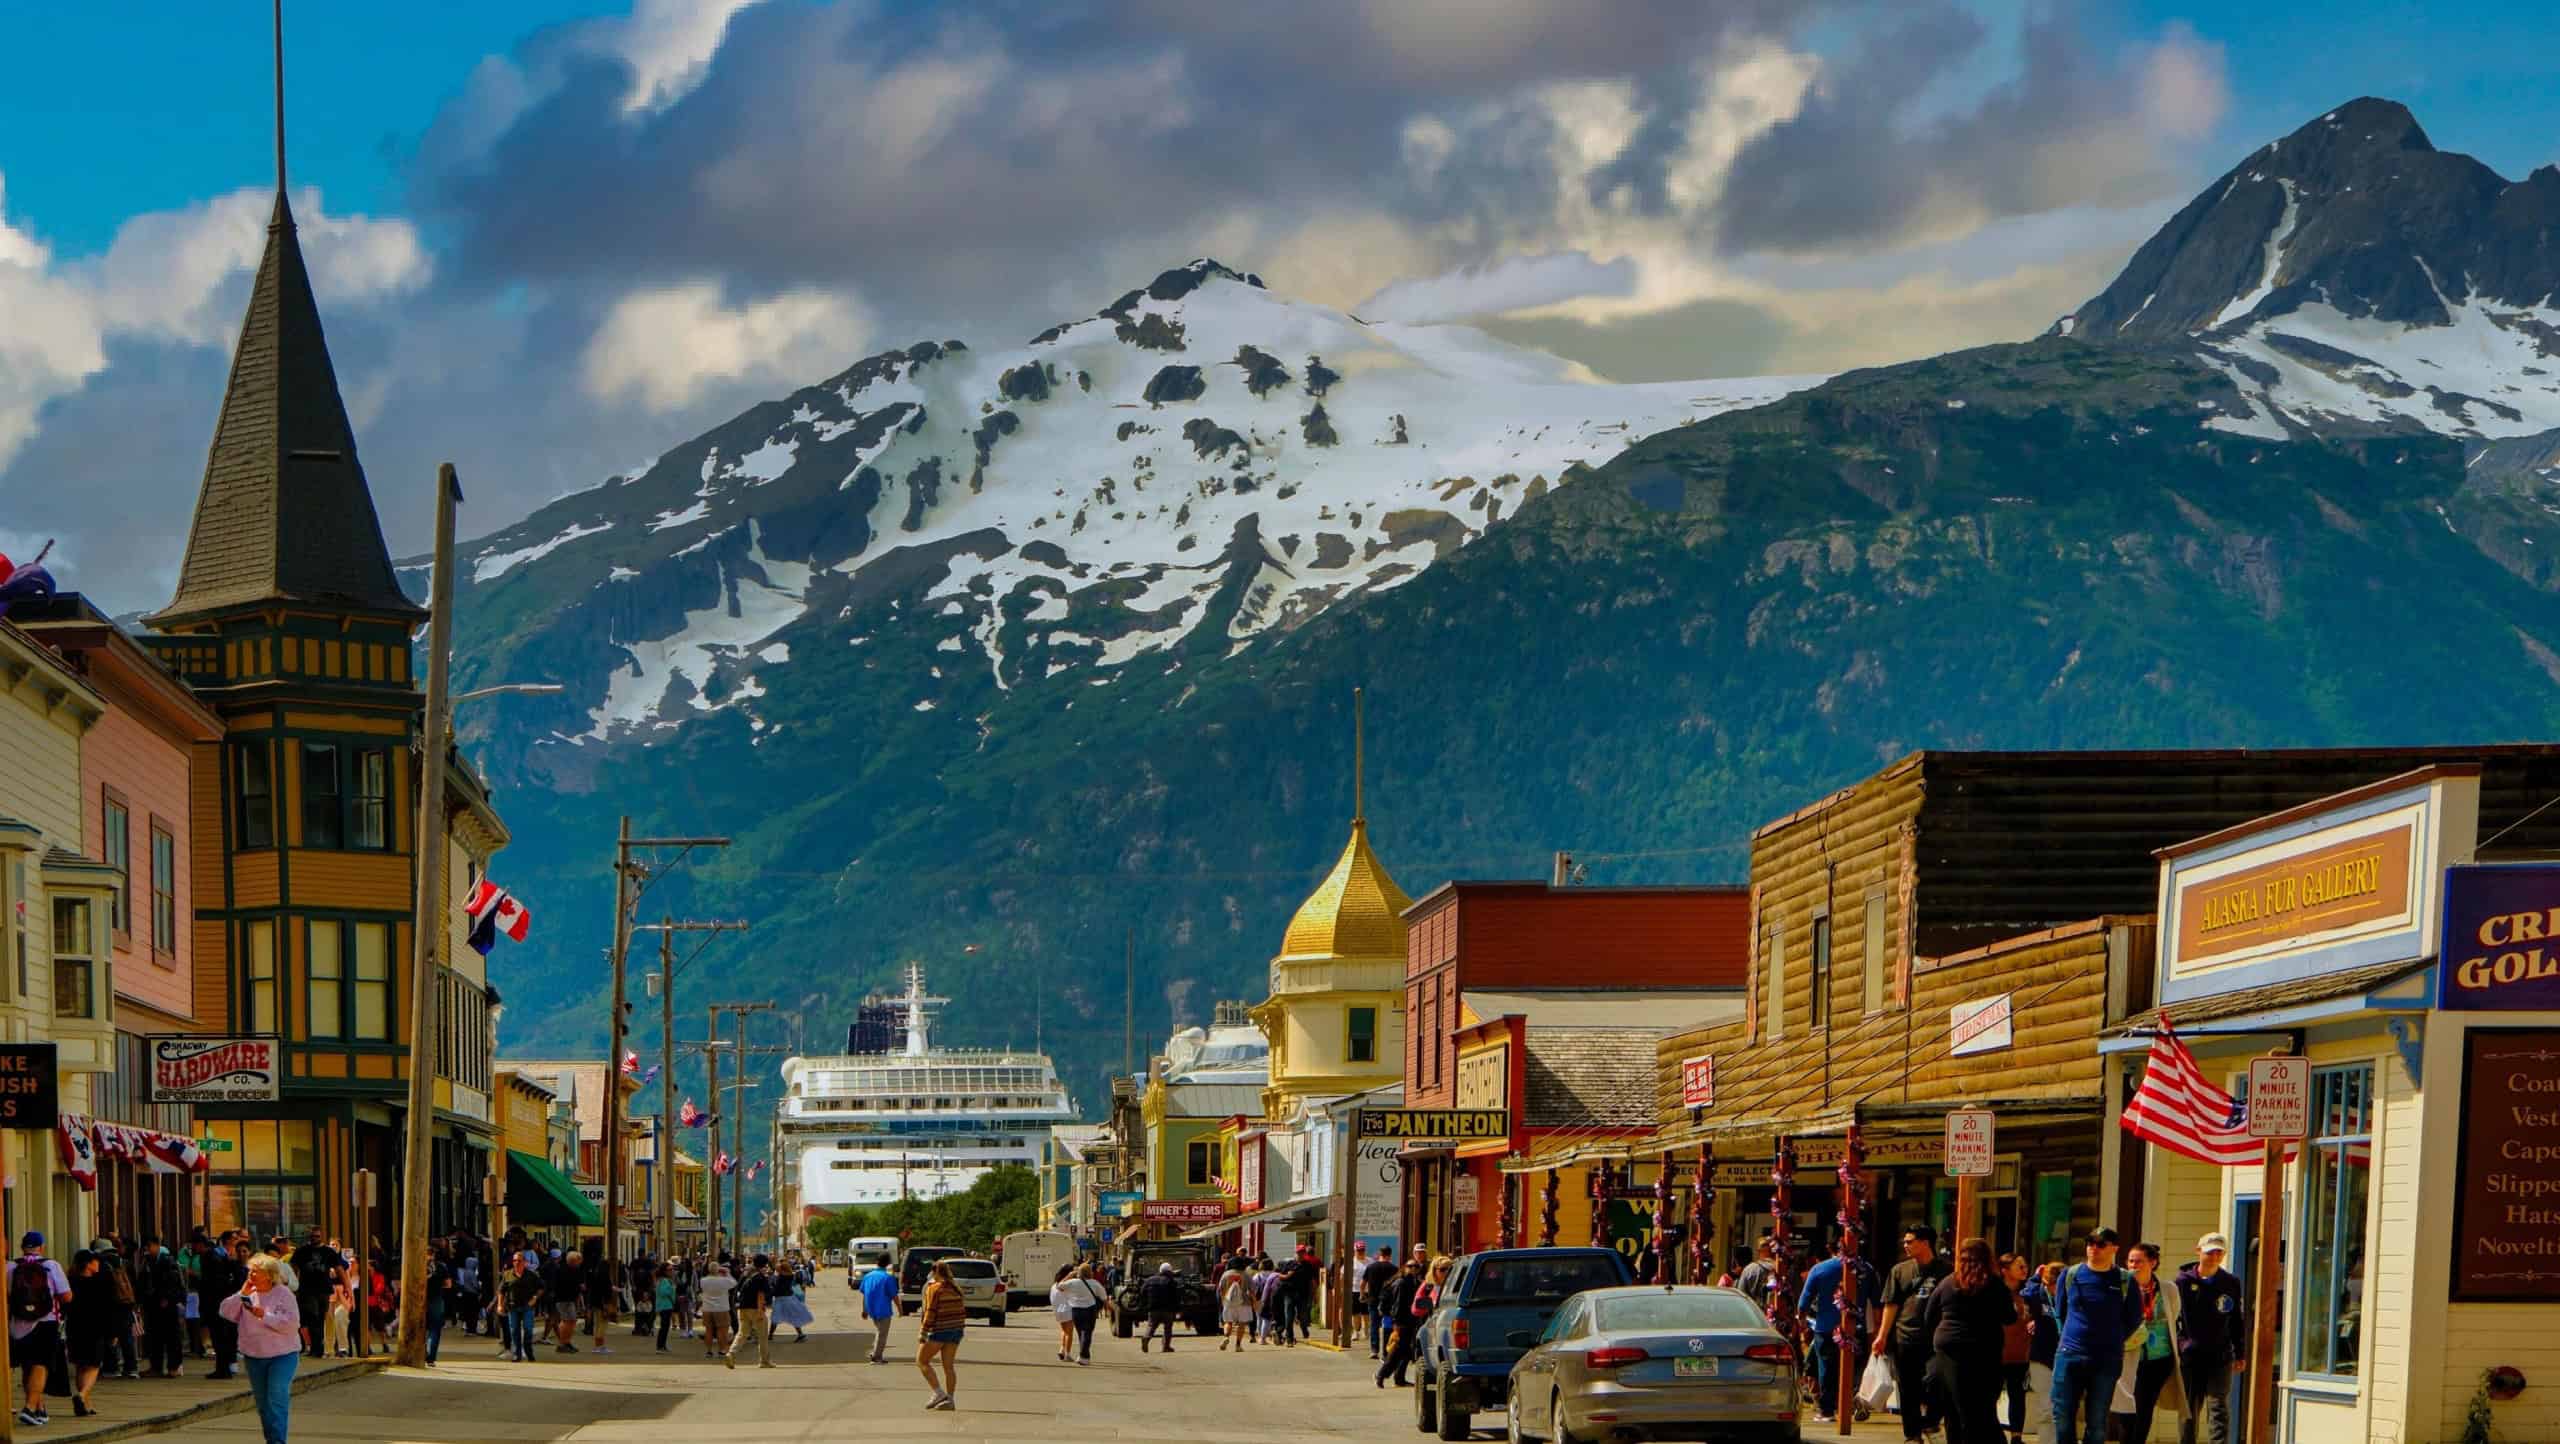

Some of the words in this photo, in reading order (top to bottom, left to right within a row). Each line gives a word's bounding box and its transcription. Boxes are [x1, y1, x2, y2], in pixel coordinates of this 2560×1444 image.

[2200, 887, 2259, 933] ALASKA
[2264, 877, 2297, 917] FUR
[2302, 855, 2382, 908] GALLERY
[157, 1042, 270, 1088] HARDWARE
[2270, 1066, 2289, 1080] 20
[2260, 1083, 2297, 1095] MINUTE
[2255, 1098, 2301, 1110] PARKING
[1384, 1112, 1504, 1137] PANTHEON
[1962, 1119, 1977, 1130] 20
[1954, 1131, 1985, 1142] MINUTE
[1951, 1143, 1987, 1153] PARKING
[1146, 1204, 1190, 1216] MINER'S
[1191, 1204, 1221, 1216] GEMS
